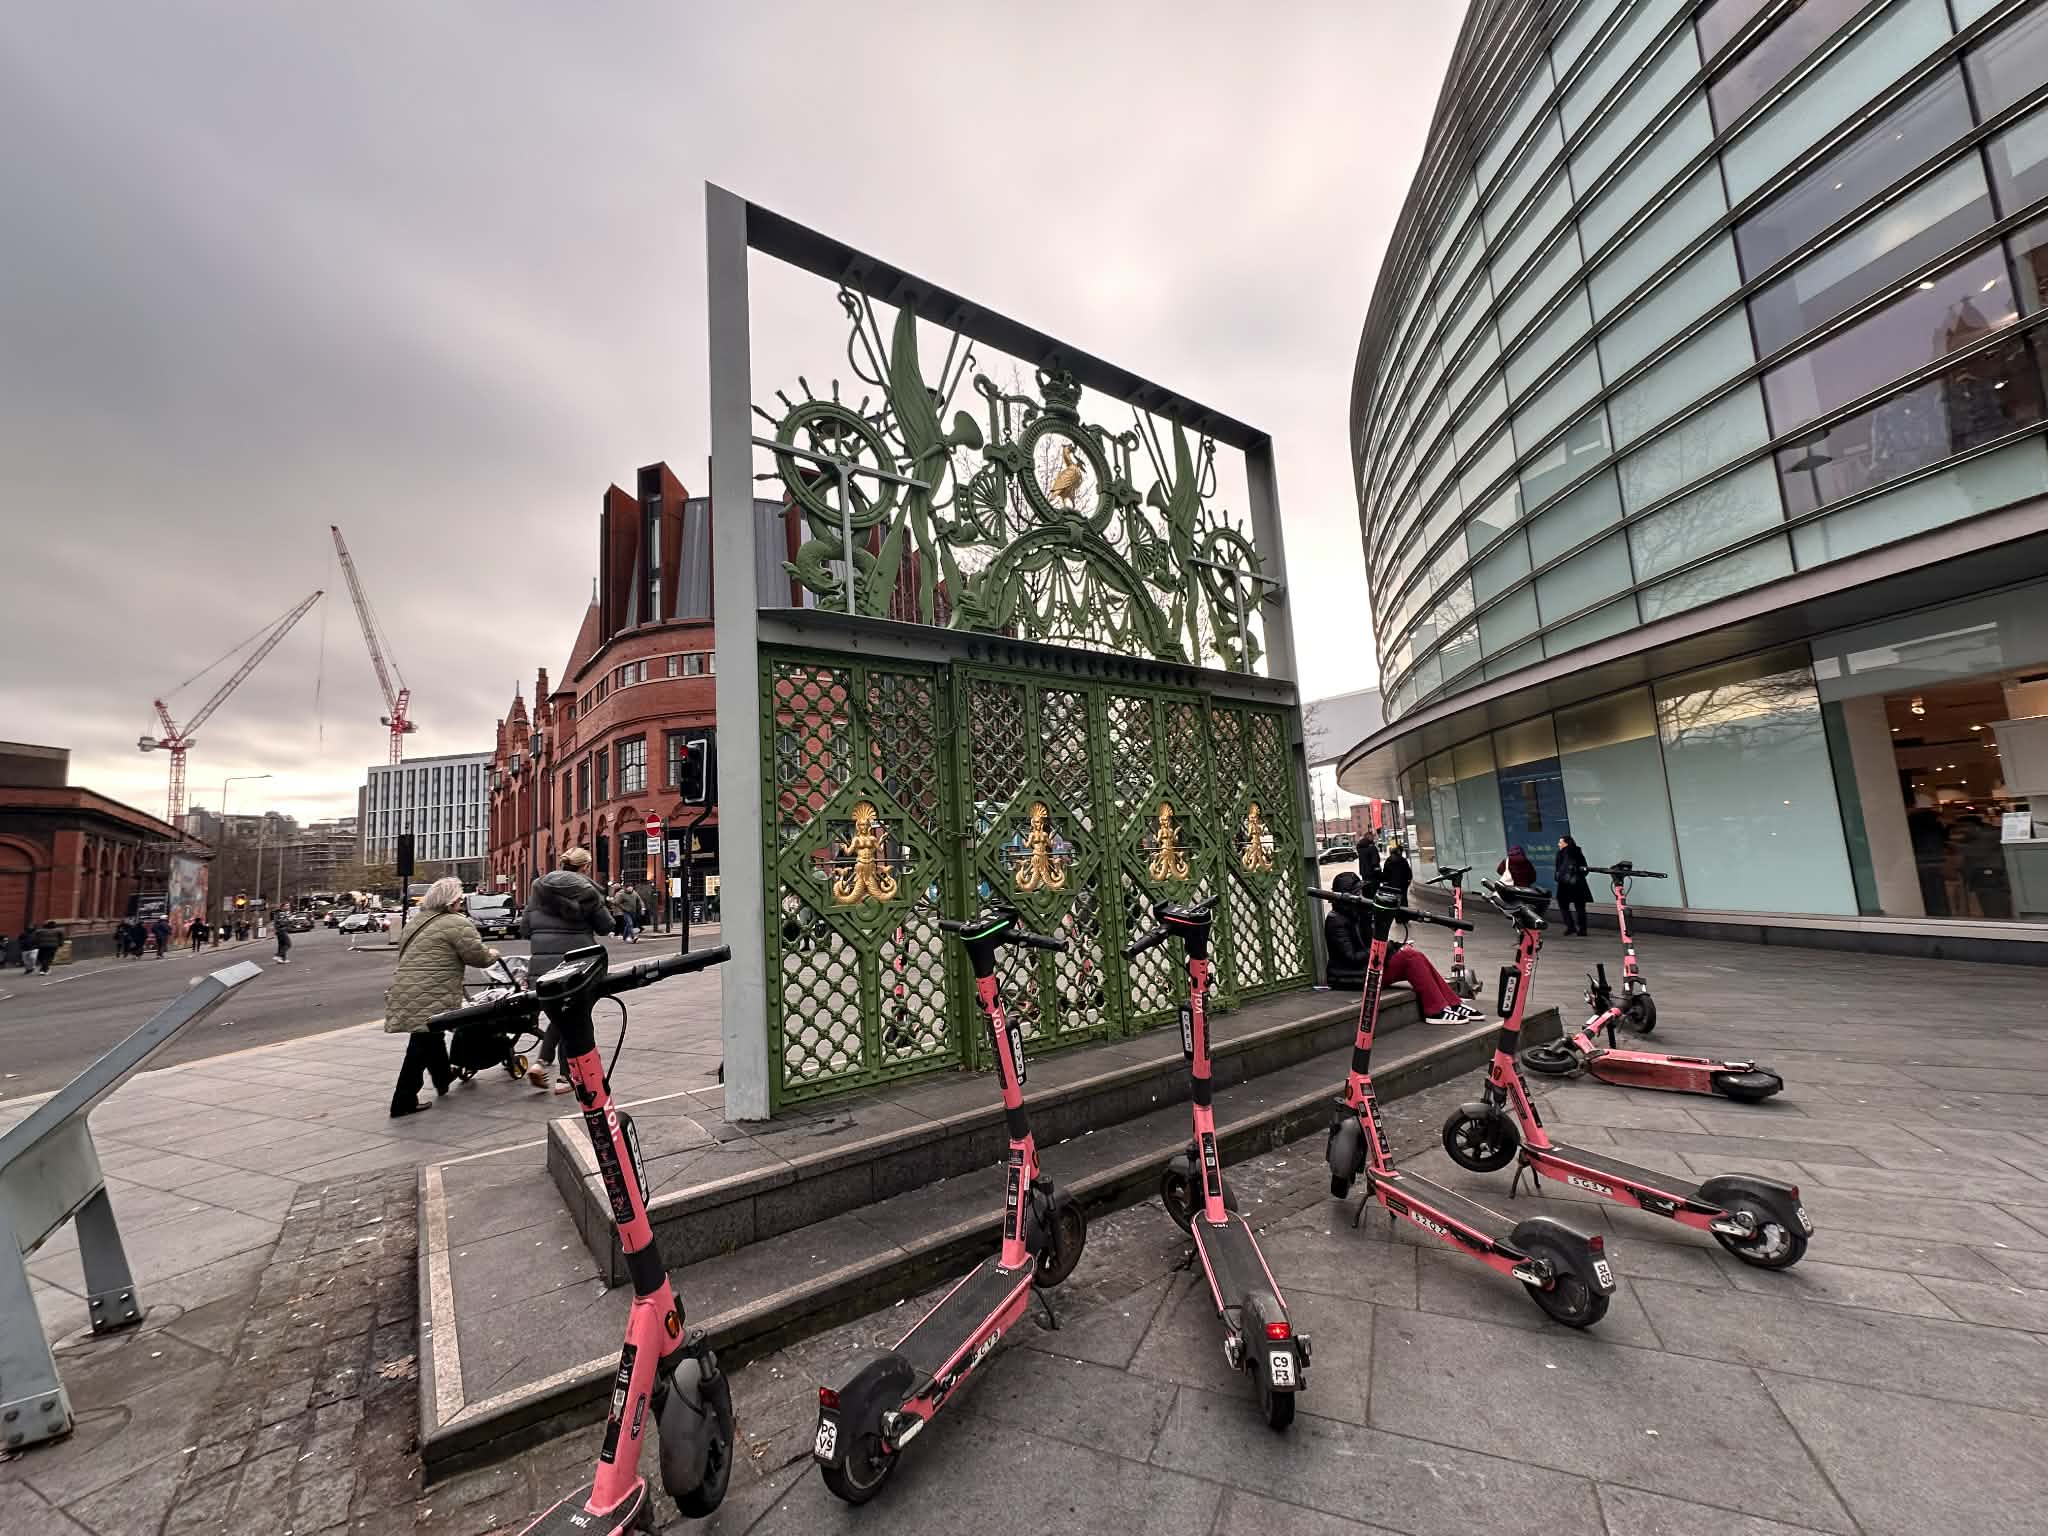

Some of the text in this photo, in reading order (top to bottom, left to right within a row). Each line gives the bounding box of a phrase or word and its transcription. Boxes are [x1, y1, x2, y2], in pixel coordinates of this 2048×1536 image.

[1272, 1356, 1289, 1368] C9
[1275, 1369, 1289, 1381] F3
[820, 1423, 836, 1439] PC
[819, 1437, 833, 1452] V9
